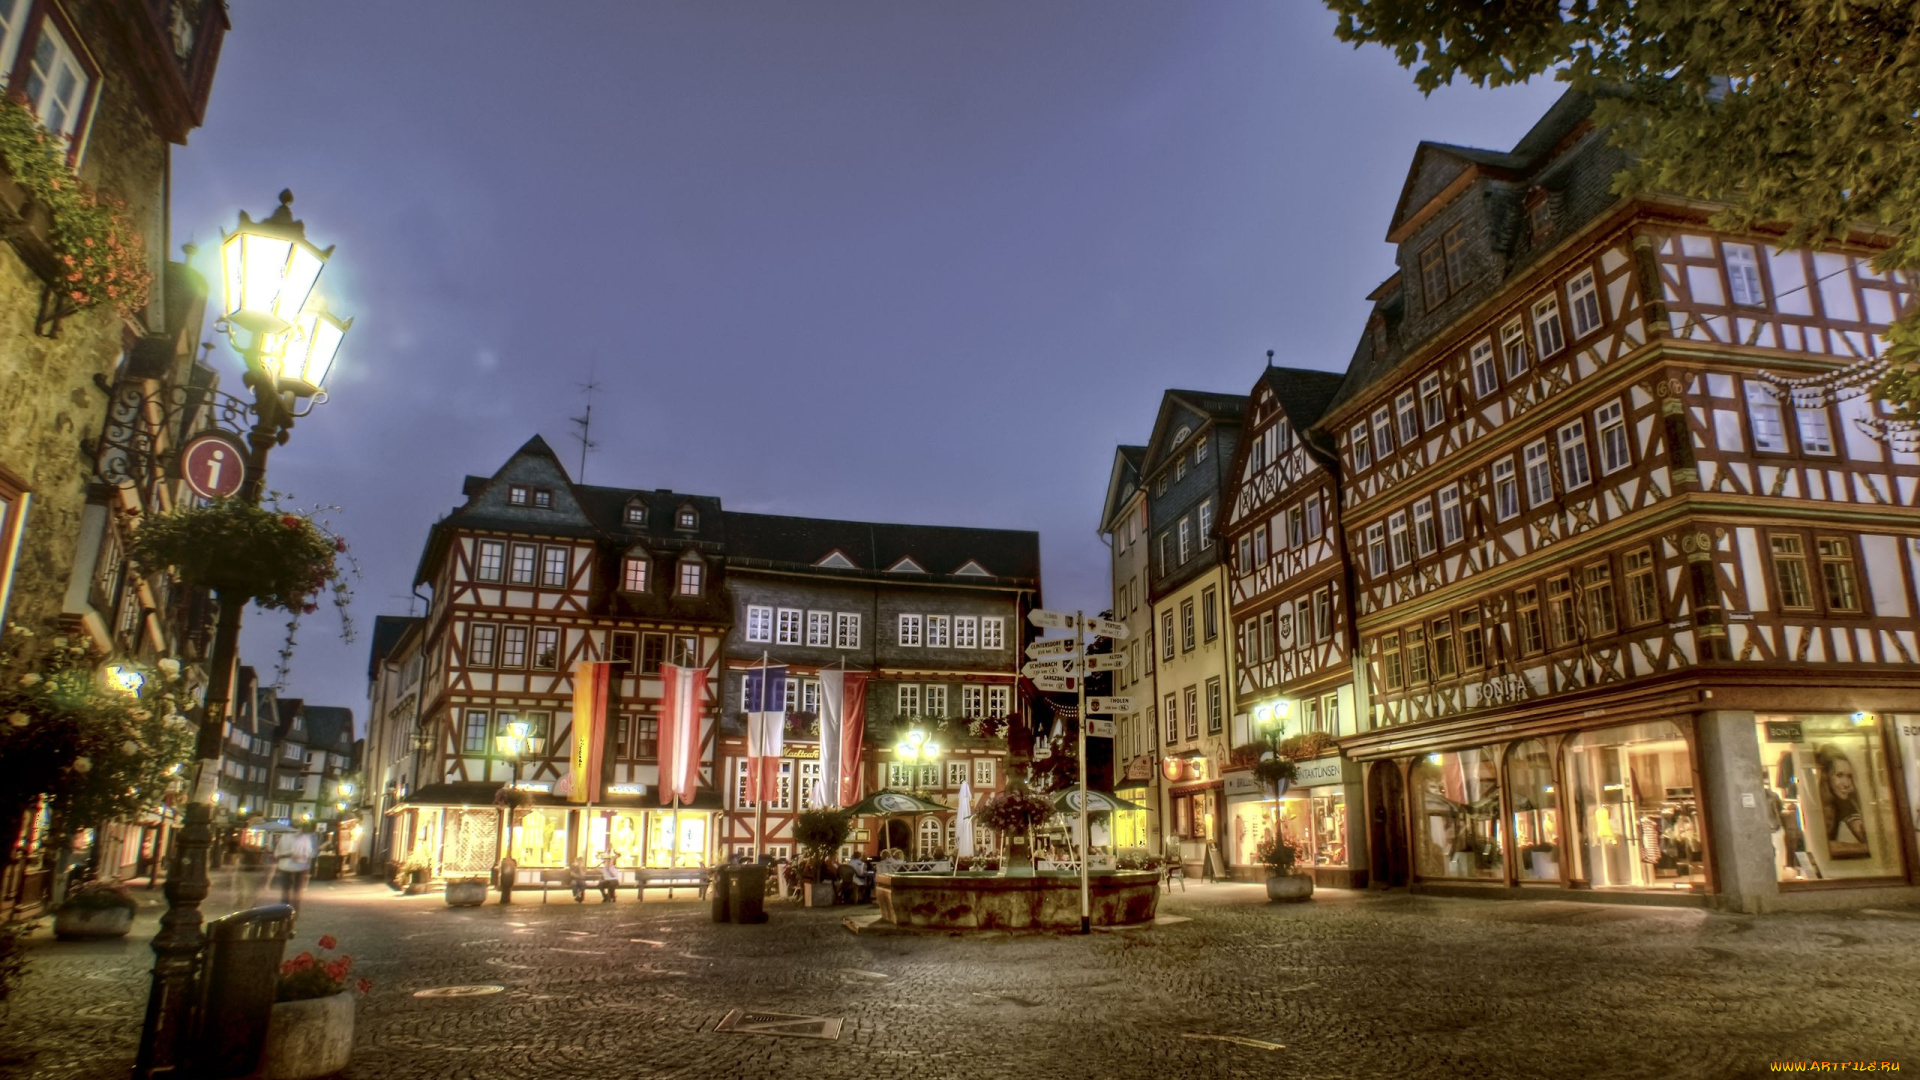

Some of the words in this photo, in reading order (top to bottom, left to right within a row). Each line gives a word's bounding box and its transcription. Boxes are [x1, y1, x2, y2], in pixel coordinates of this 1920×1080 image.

[1029, 661, 1058, 669] SCHÖNBACH
[1475, 674, 1527, 702] BONITA
[1770, 728, 1800, 738] BONITA
[1903, 725, 1920, 736] BO
